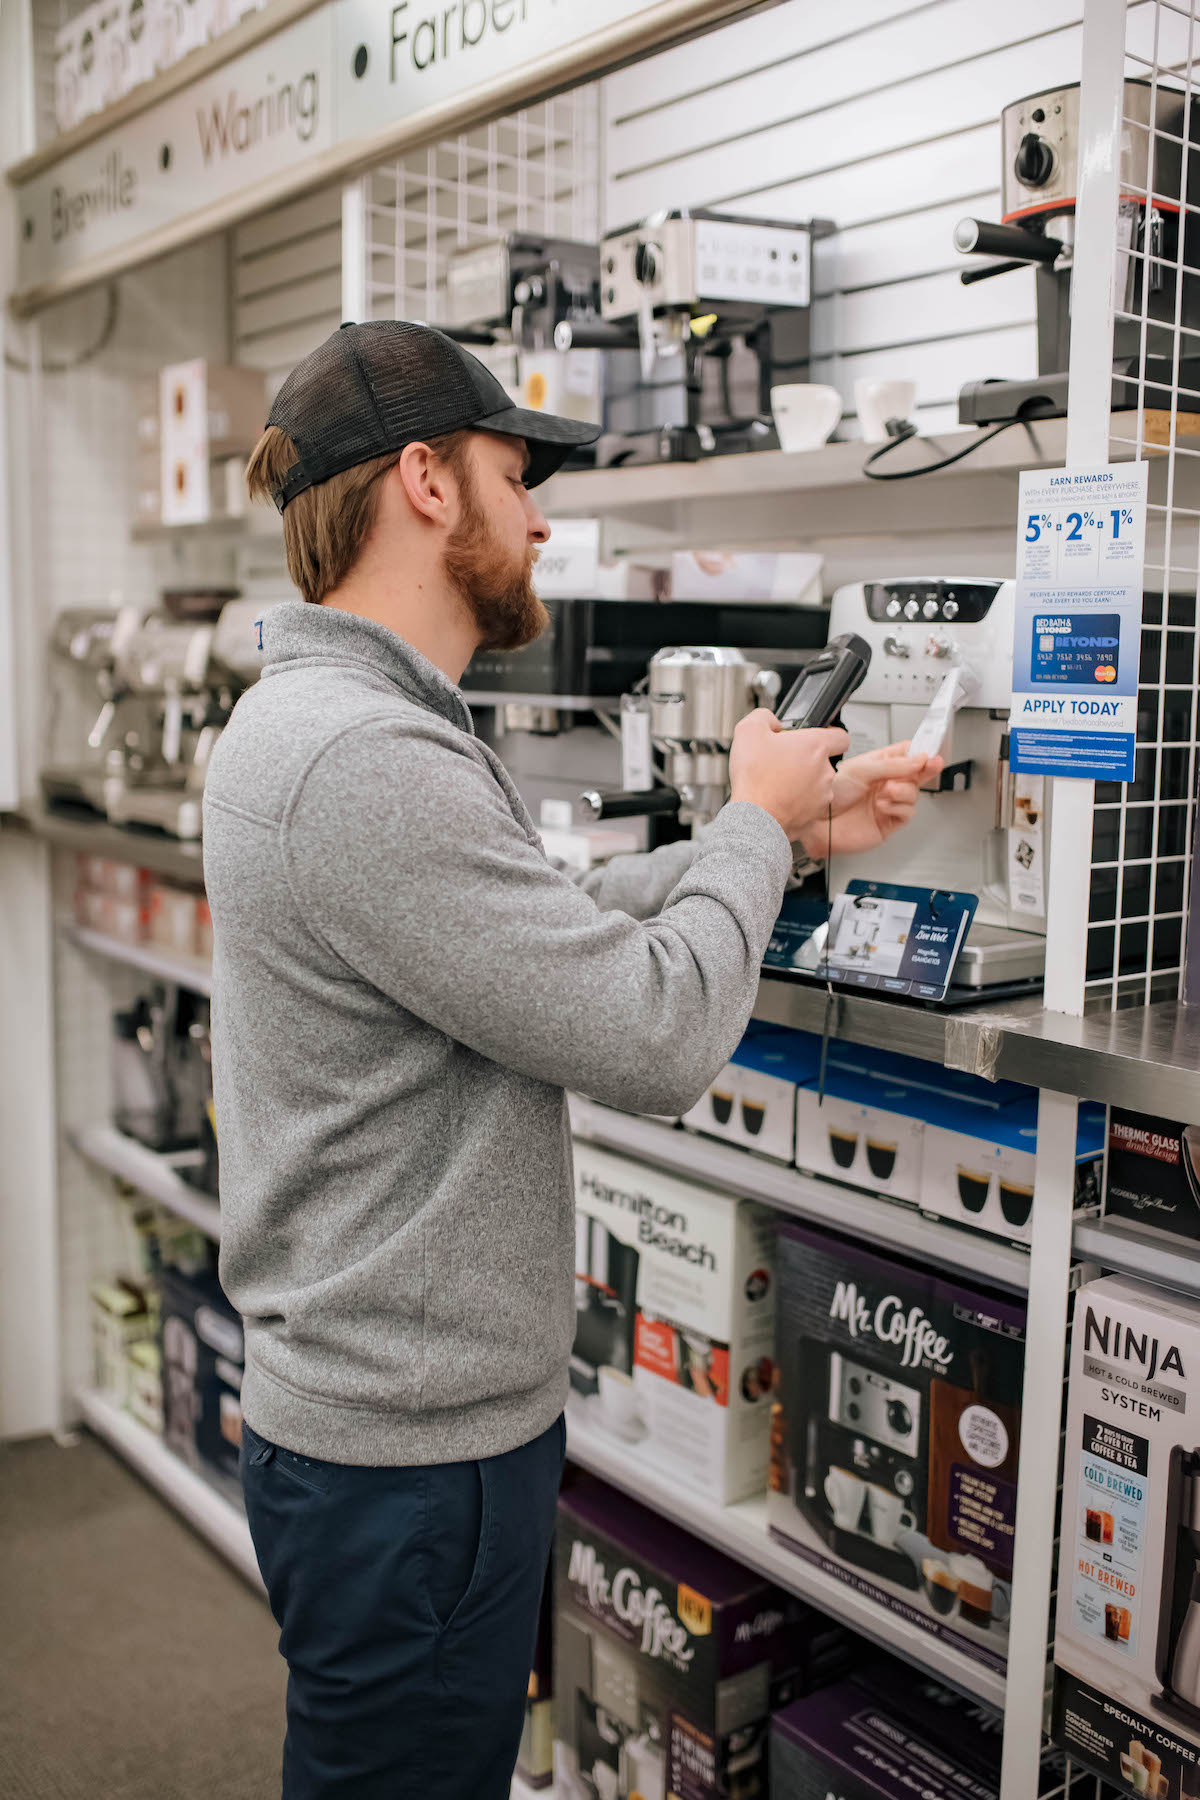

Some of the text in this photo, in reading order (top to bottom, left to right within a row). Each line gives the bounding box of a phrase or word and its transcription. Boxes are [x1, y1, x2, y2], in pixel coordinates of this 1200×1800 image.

[197, 70, 319, 168] Waring
[1041, 487, 1059, 496] EVERY
[1050, 473, 1113, 486] EARN REWARDS
[1025, 513, 1052, 542] 5%
[1066, 511, 1095, 541] 2%
[1110, 508, 1133, 539] 1%
[1036, 617, 1072, 627] BED BATH &
[1036, 626, 1072, 634] BEYOND
[1055, 636, 1119, 648] BEYOND
[1056, 653, 1073, 661] 7512
[1076, 653, 1093, 661] 3456
[1023, 699, 1066, 714] APPLY
[1113, 1123, 1180, 1152] THERMIC GLASS
[580, 1171, 687, 1233] Hamilton
[638, 1219, 717, 1272] Beach
[874, 1295, 954, 1368] Coffee
[1084, 1305, 1185, 1381] NINJA
[1089, 1364, 1180, 1406] HOT & COLD BREWED
[1101, 1388, 1161, 1422] SYSTEM
[1096, 1424, 1104, 1441] 2
[1103, 1435, 1134, 1453] OVER ICE
[1091, 1441, 1138, 1470] COFFEE & TEA
[1084, 1466, 1104, 1484] COLD
[1107, 1476, 1143, 1501] BREWED
[1079, 1560, 1095, 1577] HOT
[1097, 1569, 1136, 1597] BREWED
[611, 1567, 696, 1657] Coffee
[1065, 1714, 1114, 1749] CONCENTRATES
[1103, 1702, 1196, 1763] SPECIALTY COFFEE
